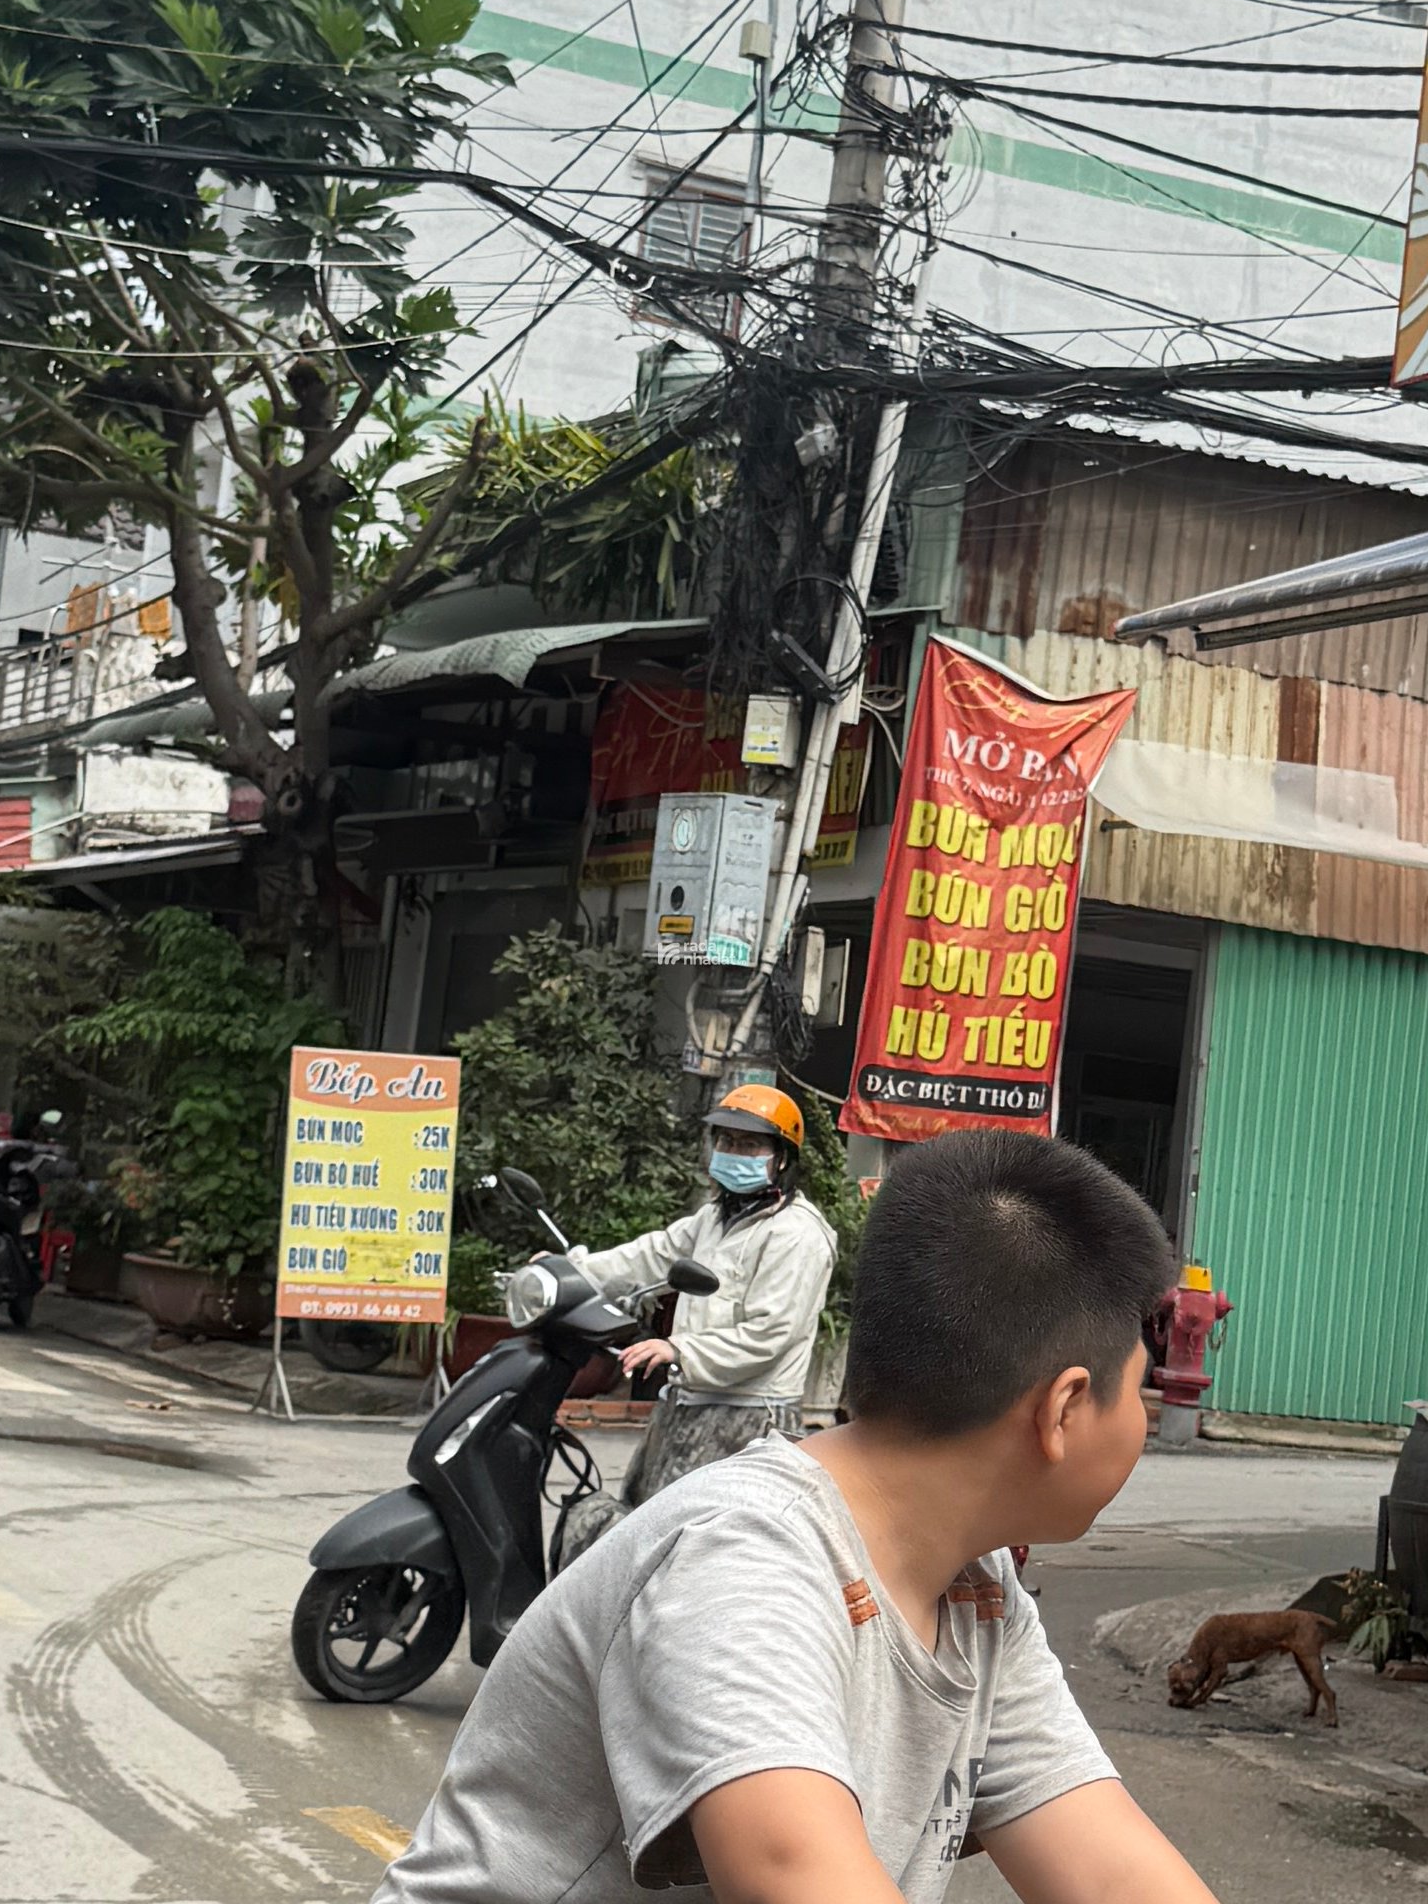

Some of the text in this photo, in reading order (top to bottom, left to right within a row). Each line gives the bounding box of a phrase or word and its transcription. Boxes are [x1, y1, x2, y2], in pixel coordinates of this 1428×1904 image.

[942, 728, 1016, 772] MỞ
[906, 799, 1082, 876] BÚN MỌC
[904, 868, 1067, 934] BÚN GIÒ
[900, 937, 1058, 1002] BÚN BÒ
[884, 998, 1053, 1069] HỦ TIẾU
[306, 1058, 446, 1104] Bếp An
[866, 1073, 915, 1100] ĐẶC
[918, 1081, 972, 1107] BIỆT
